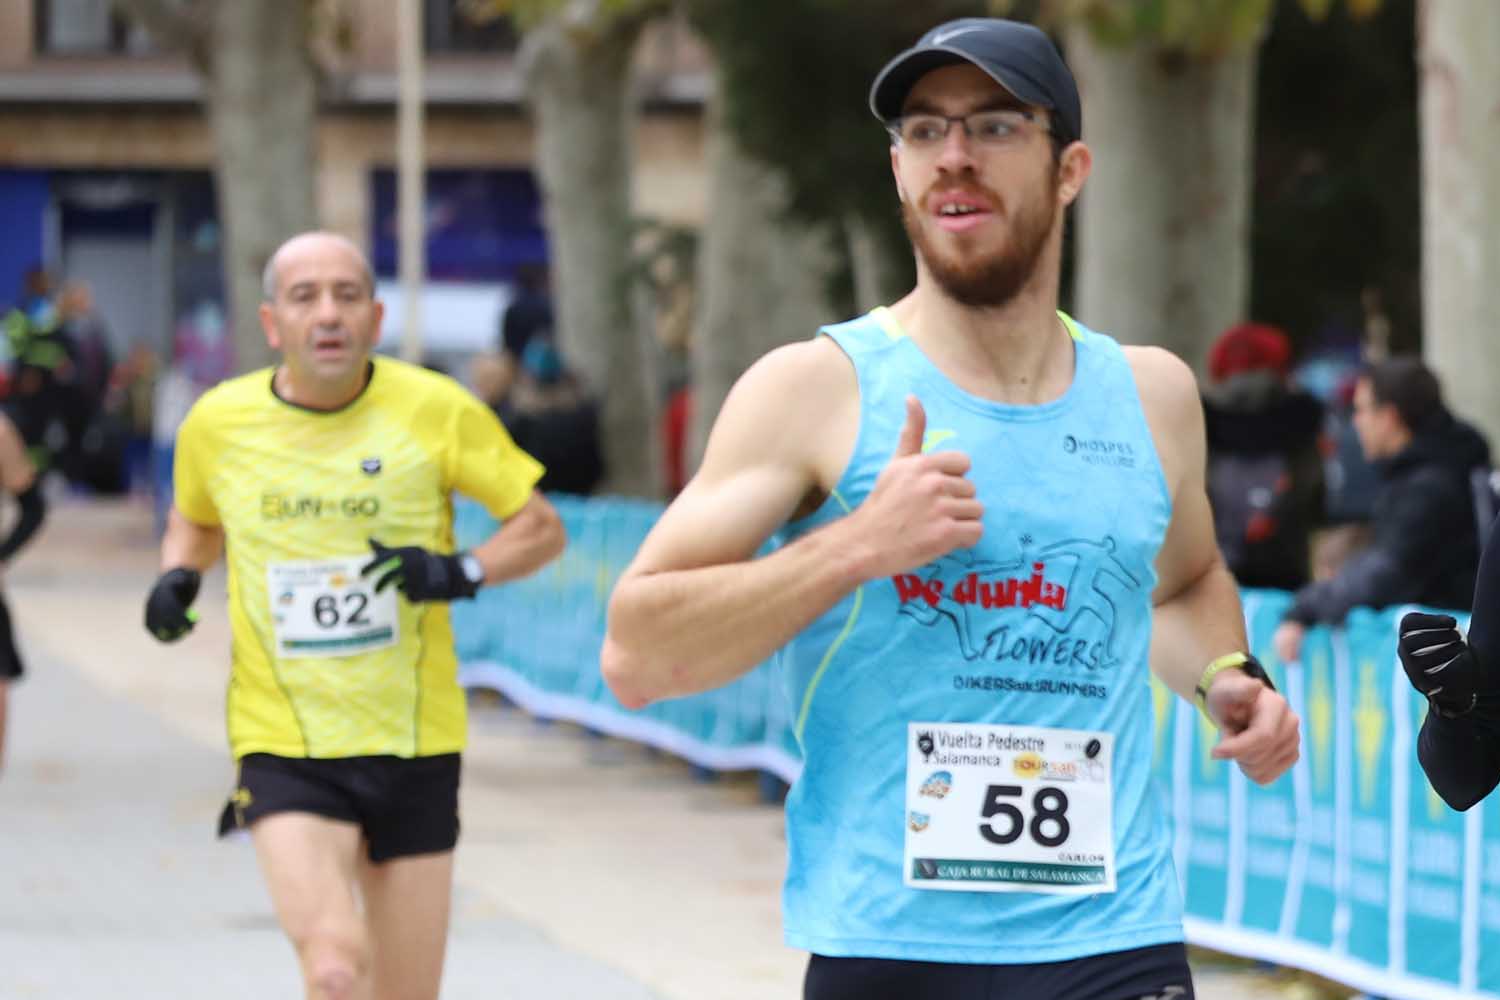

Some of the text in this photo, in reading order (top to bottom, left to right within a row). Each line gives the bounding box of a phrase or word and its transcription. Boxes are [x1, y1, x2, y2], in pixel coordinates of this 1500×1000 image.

[312, 592, 370, 629] 62
[980, 625, 1102, 670] FLOWERS
[938, 728, 1046, 752] Vuelta Pedestre
[979, 784, 1070, 848] 58
